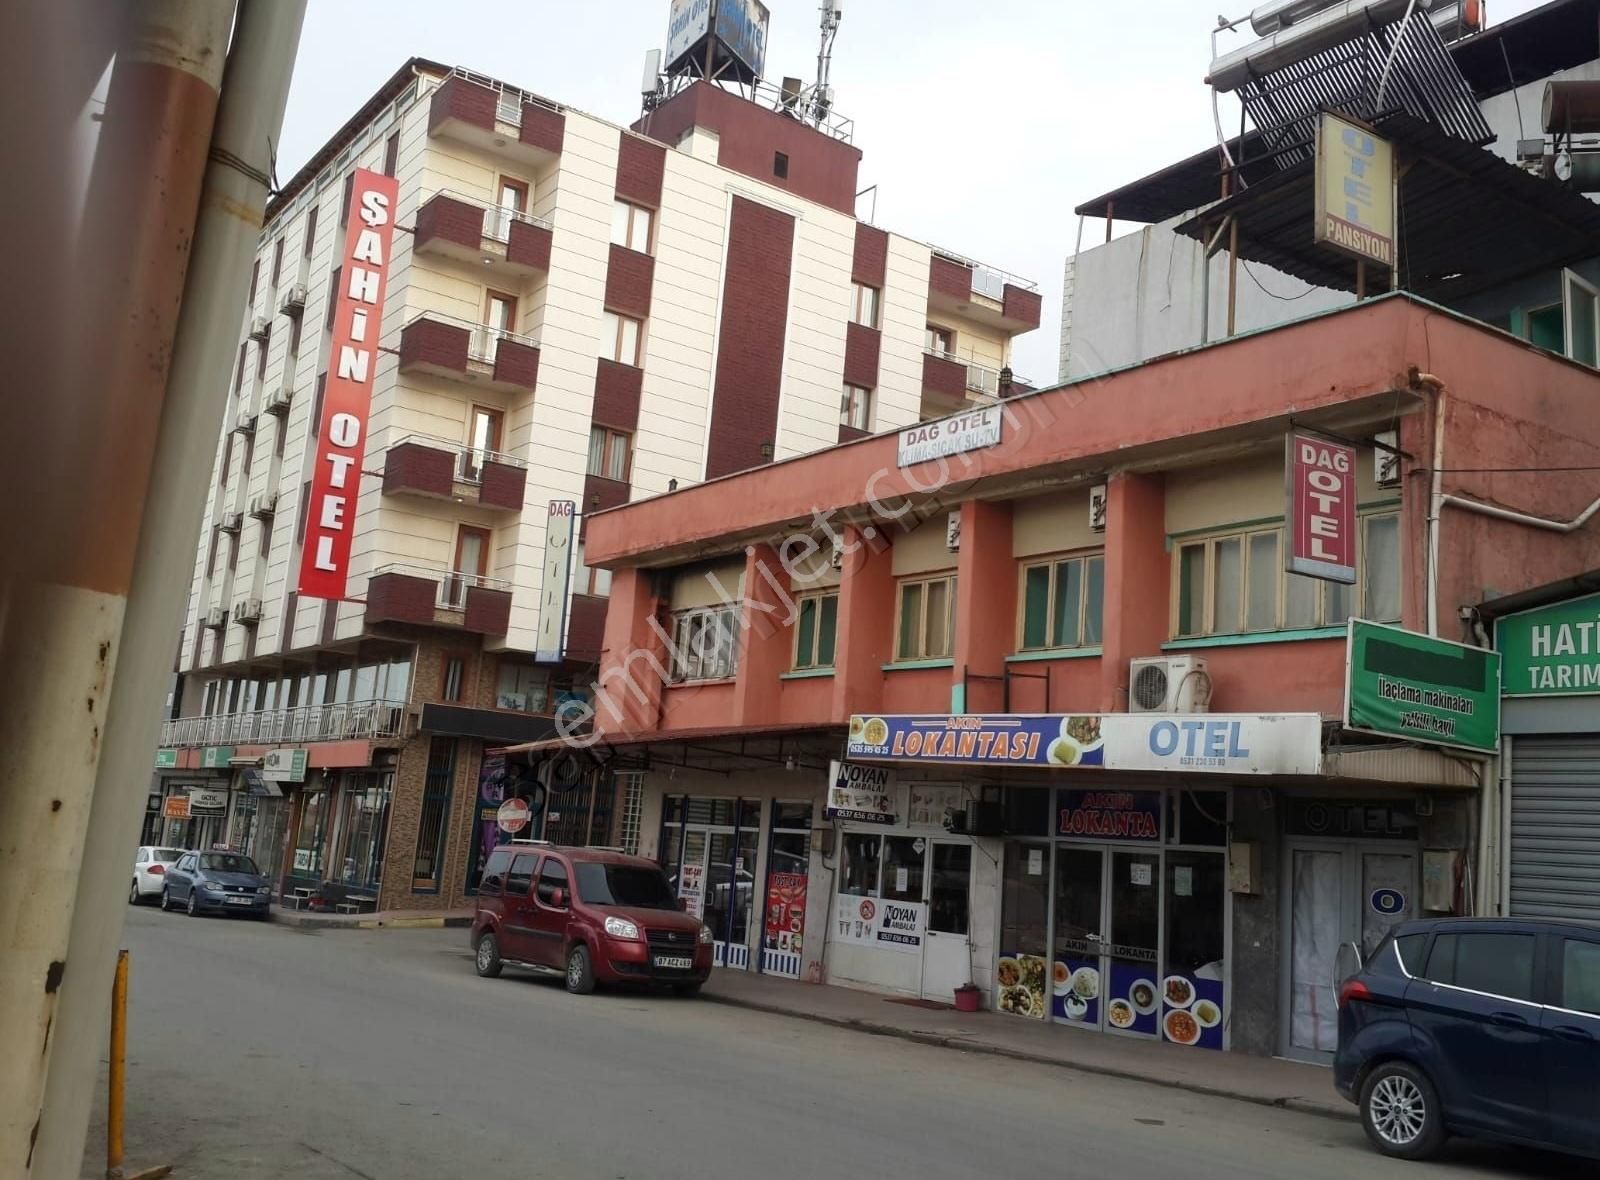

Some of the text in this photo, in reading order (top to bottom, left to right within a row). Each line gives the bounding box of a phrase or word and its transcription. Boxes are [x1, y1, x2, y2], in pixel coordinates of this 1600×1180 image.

[315, 190, 390, 572] ŞAHİN OTEL
[947, 411, 992, 436] OTEL
[1301, 444, 1349, 473] DAĞ
[1308, 470, 1342, 561] OTEL
[892, 731, 1040, 759] LOKANTASI
[1149, 720, 1250, 758] OTEL
[838, 763, 889, 784] NOYAN
[1060, 808, 1157, 837] LOKANTA
[1304, 802, 1403, 834] OTEL
[885, 905, 917, 922] NOYAN
[891, 921, 917, 932] AMBALAJ
